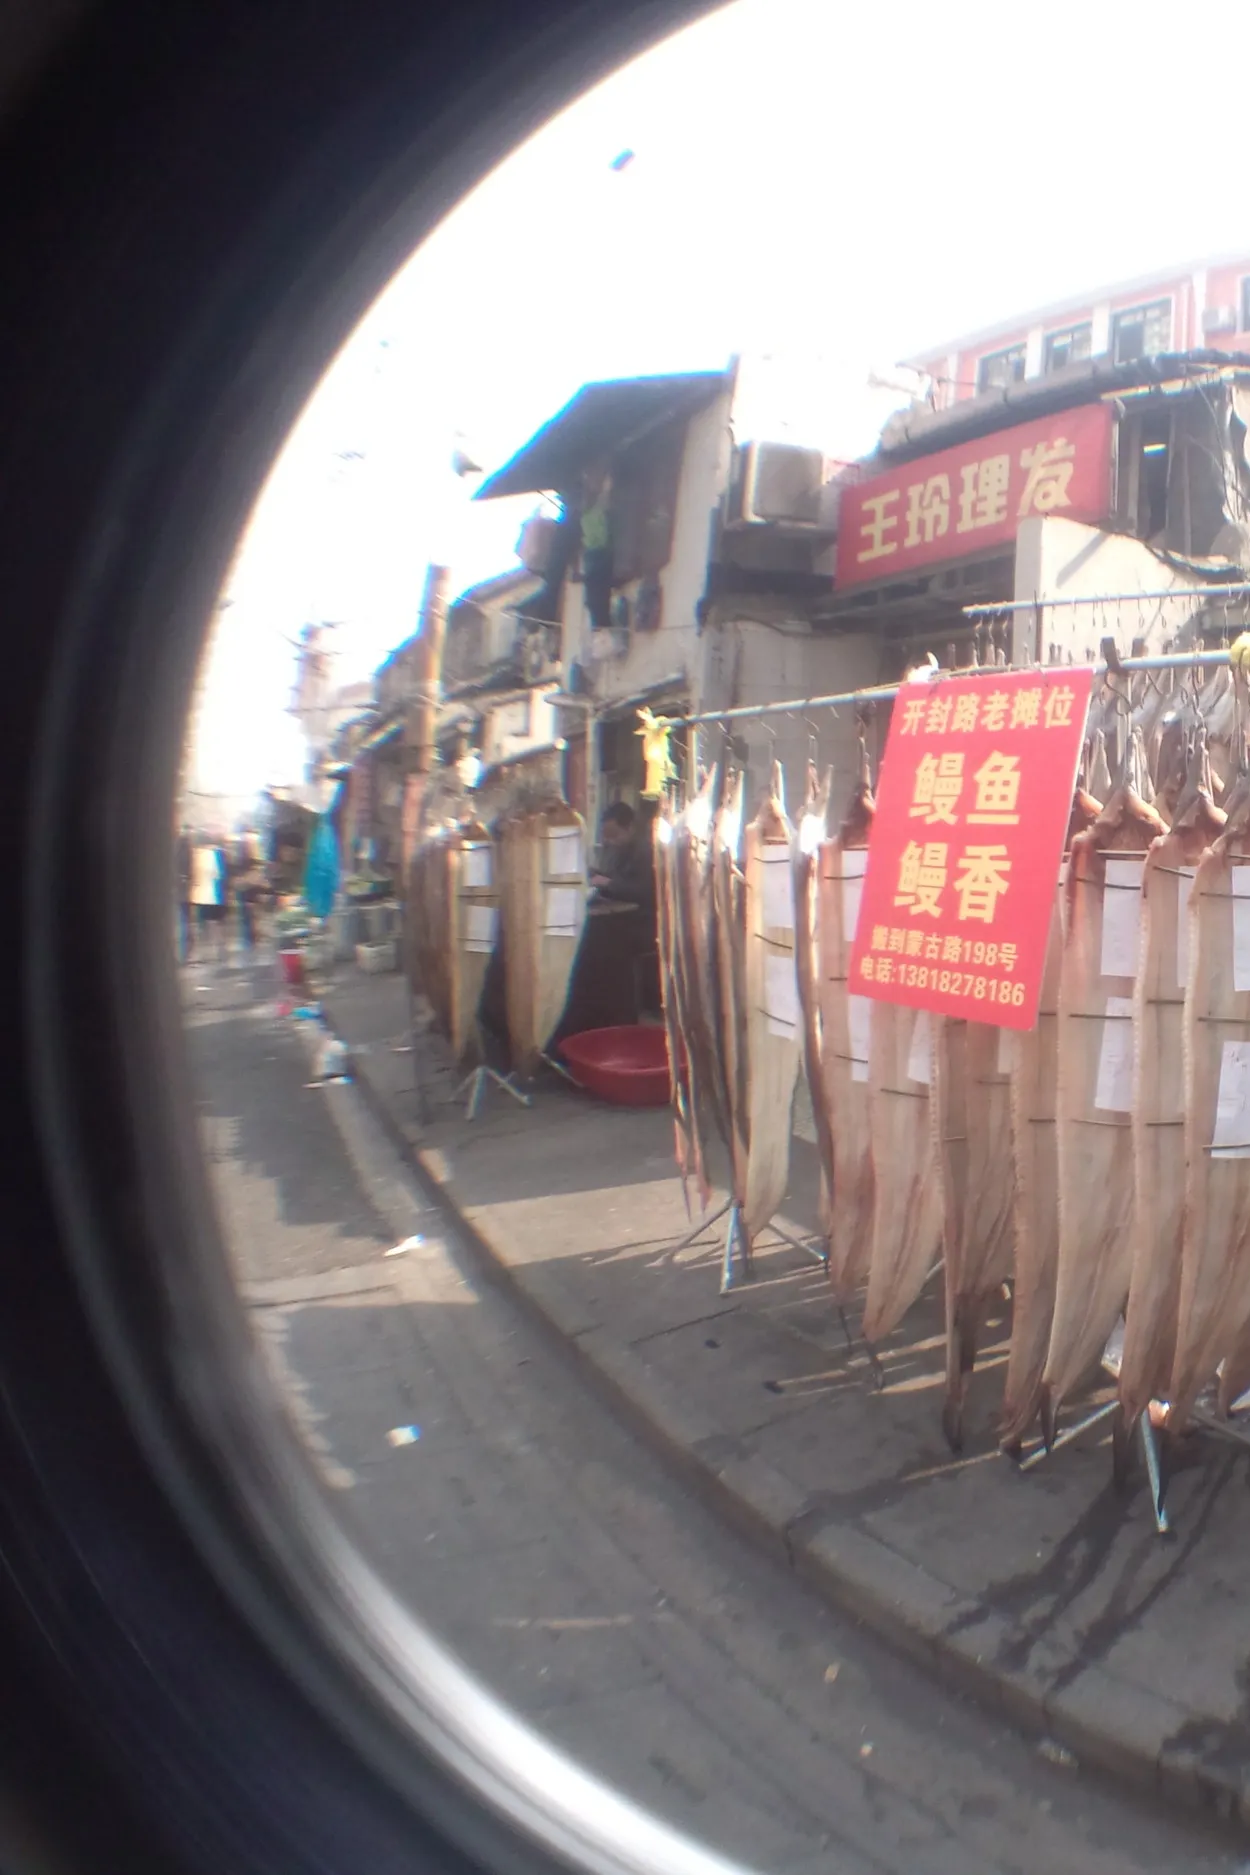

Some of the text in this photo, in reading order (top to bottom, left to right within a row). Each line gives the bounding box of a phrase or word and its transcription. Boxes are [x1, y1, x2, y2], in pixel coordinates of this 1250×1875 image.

[857, 437, 1075, 562] 王玲理发
[901, 685, 1075, 736] 开封路老摊位
[909, 750, 1022, 826] 鳗鱼
[894, 840, 1012, 925] 鳗香
